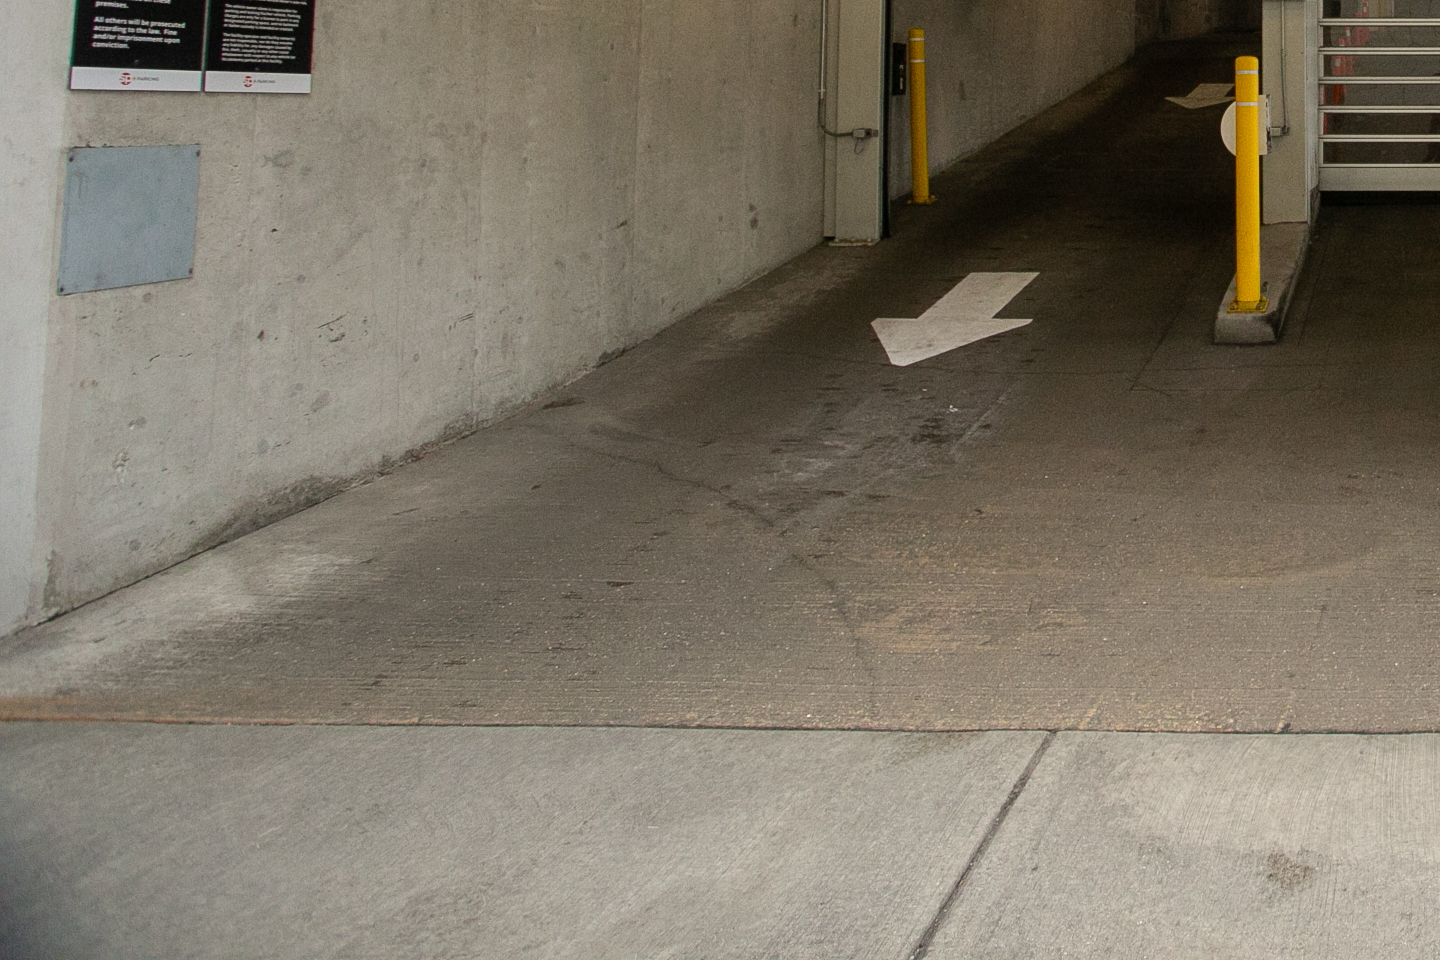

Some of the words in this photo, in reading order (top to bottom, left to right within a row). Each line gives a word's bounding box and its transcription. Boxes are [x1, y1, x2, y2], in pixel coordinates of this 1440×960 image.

[150, 20, 186, 28] prosecuted
[93, 25, 127, 34] according
[117, 34, 163, 43] imprisonment
